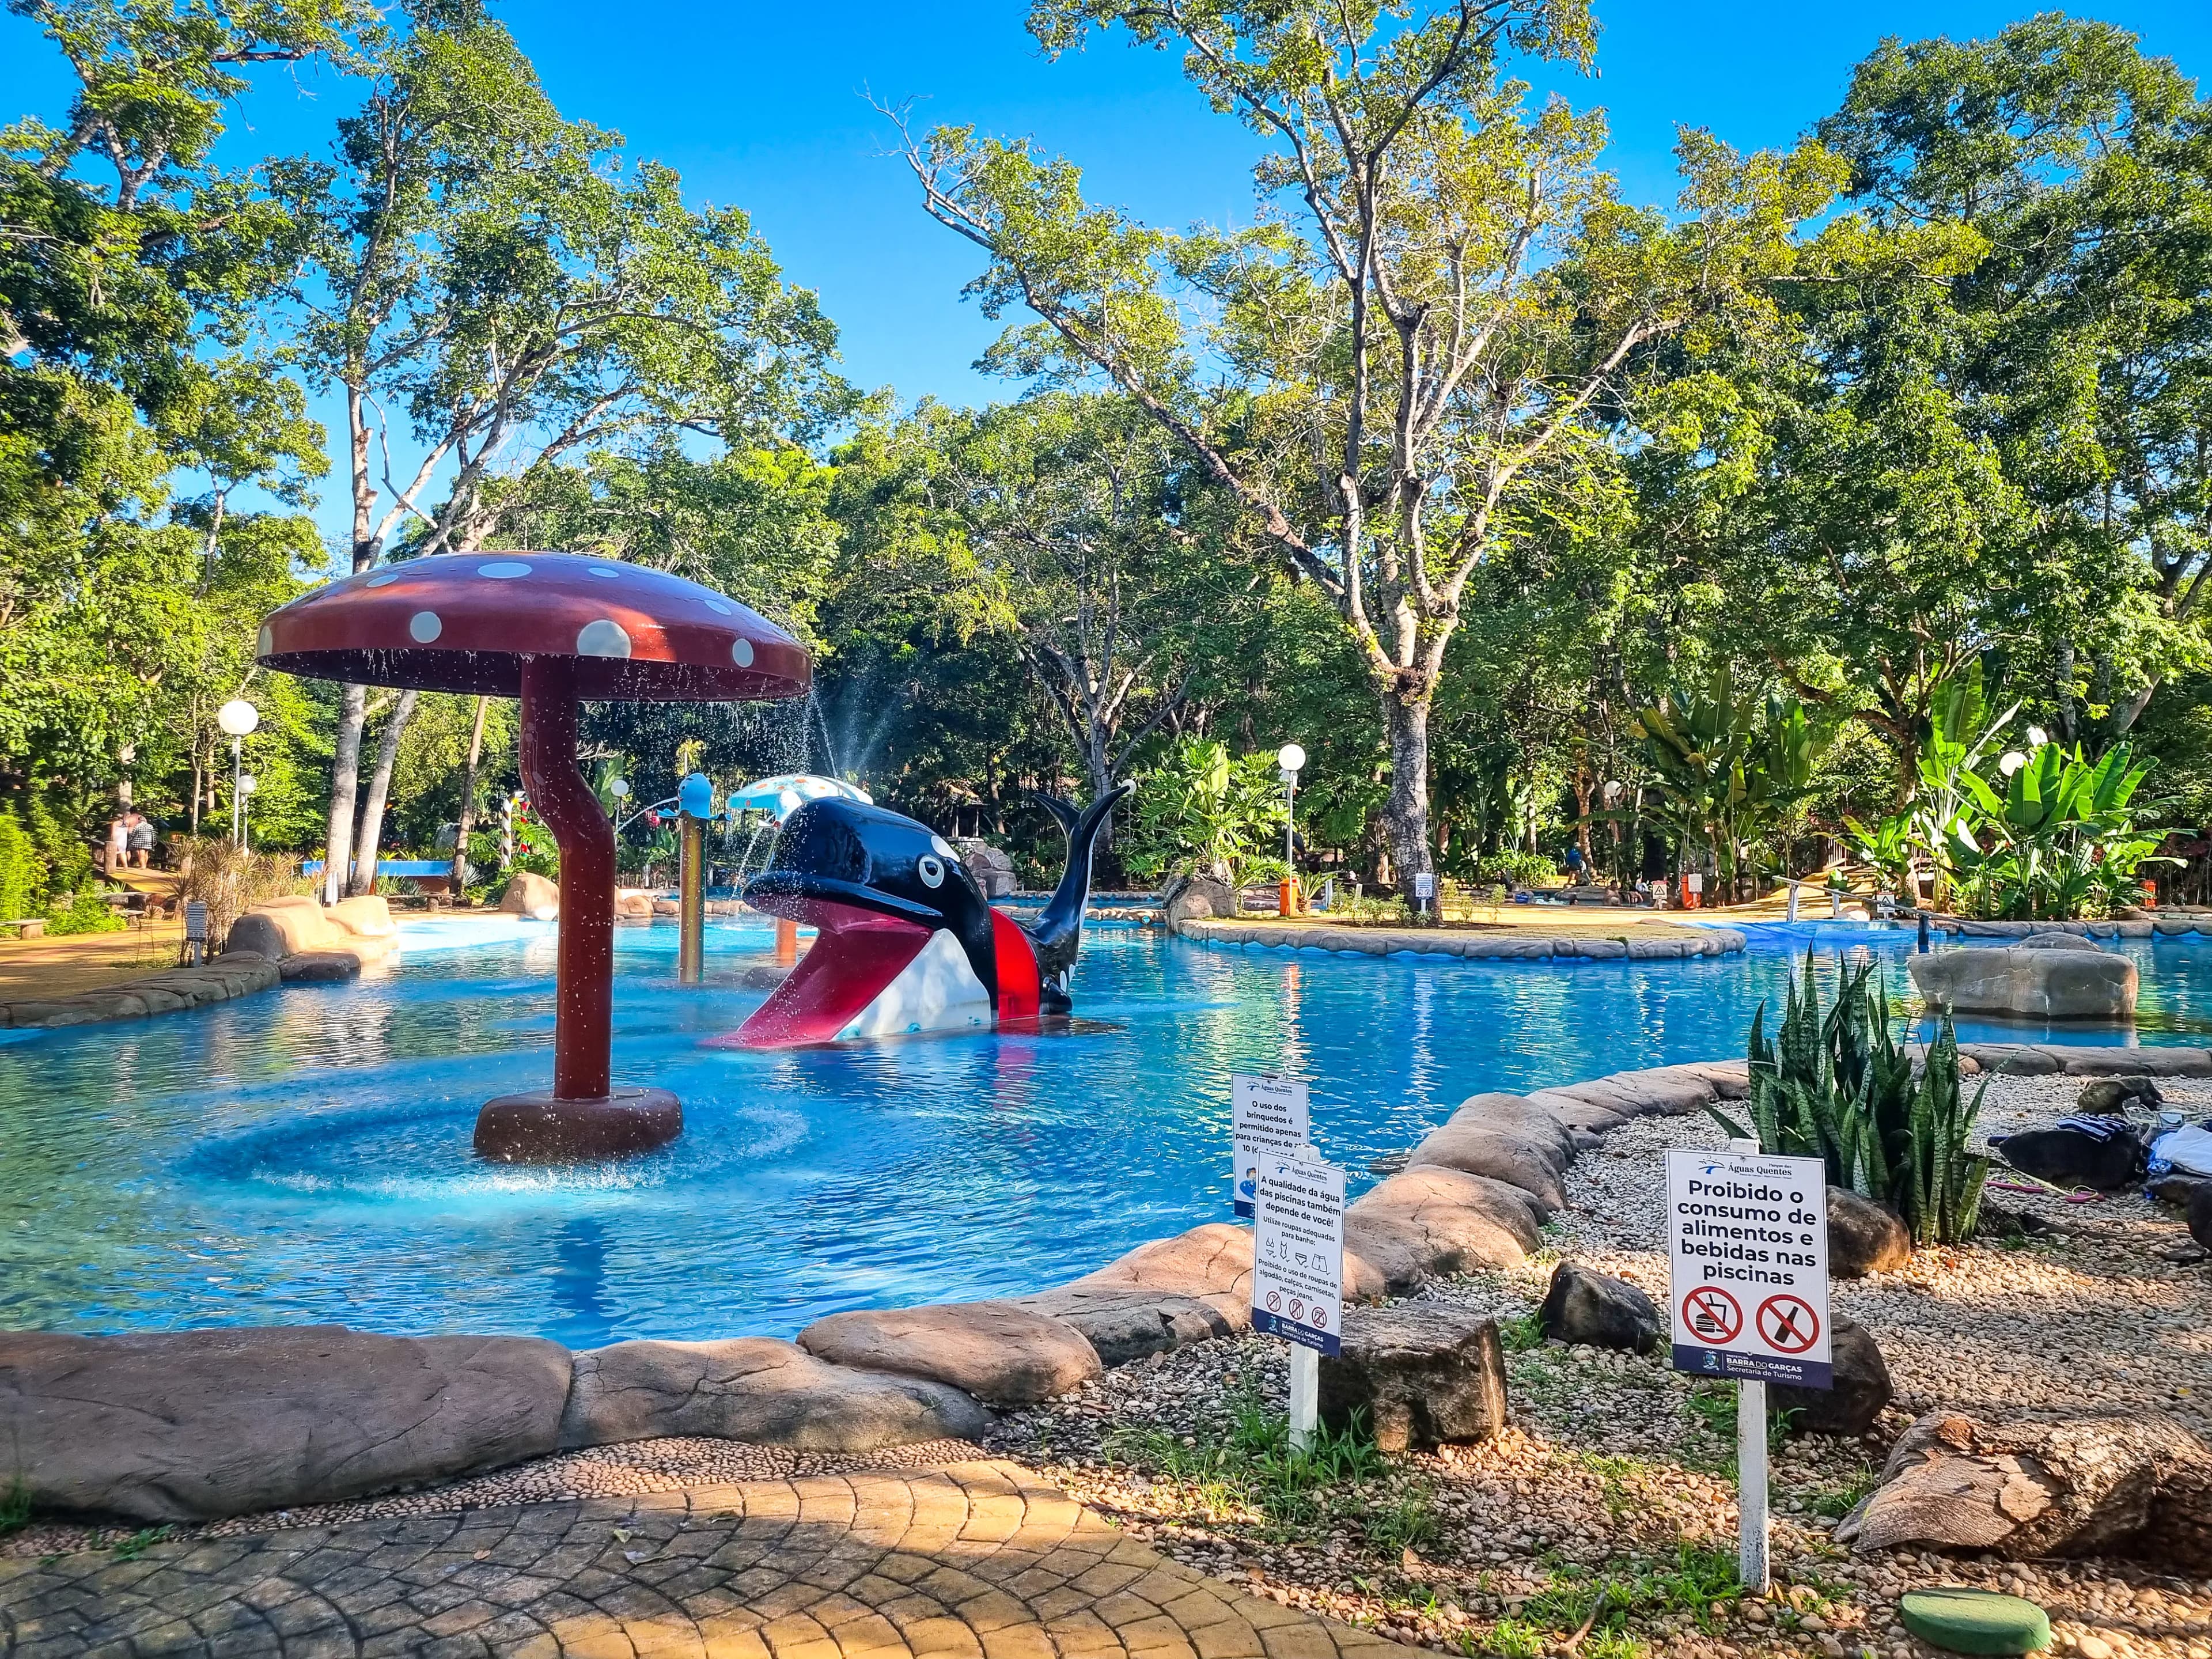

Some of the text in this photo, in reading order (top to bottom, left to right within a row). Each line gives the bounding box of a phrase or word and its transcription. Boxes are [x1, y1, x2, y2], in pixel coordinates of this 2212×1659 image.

[1247, 1111, 1293, 1124] brinquedos é
[1274, 1104, 1287, 1112] dos
[1240, 1122, 1301, 1138] permitido apenas
[1252, 1135, 1282, 1146] crianças
[1307, 1171, 1327, 1181] Quentes
[1728, 1162, 1791, 1175] Águas Quentes
[1268, 1179, 1306, 1194] qualidade
[1308, 1188, 1318, 1197] da
[1320, 1191, 1340, 1203] água
[1689, 1180, 1803, 1203] Proibido o
[1260, 1188, 1340, 1217] das piscinas também
[1266, 1202, 1334, 1227] depende de você!
[1678, 1202, 1816, 1225] consumo de
[1263, 1216, 1335, 1242] Utilize roupas adequadas
[1282, 1231, 1294, 1239] para
[1682, 1220, 1813, 1245] alimentos e
[1682, 1239, 1816, 1267] bebidas nas
[1259, 1258, 1281, 1271] Proibido
[1308, 1275, 1328, 1286] roupas
[1703, 1262, 1794, 1285] piscinas
[1259, 1269, 1336, 1299] algodão, calças, camisetas,
[1279, 1286, 1314, 1302] peças jeans.
[1282, 1323, 1297, 1332] BARRA
[1726, 1358, 1755, 1366] BARRA
[1768, 1363, 1802, 1372] GARÇAS
[1727, 1365, 1761, 1374] Secretaria
[1773, 1372, 1802, 1380] Turismo
